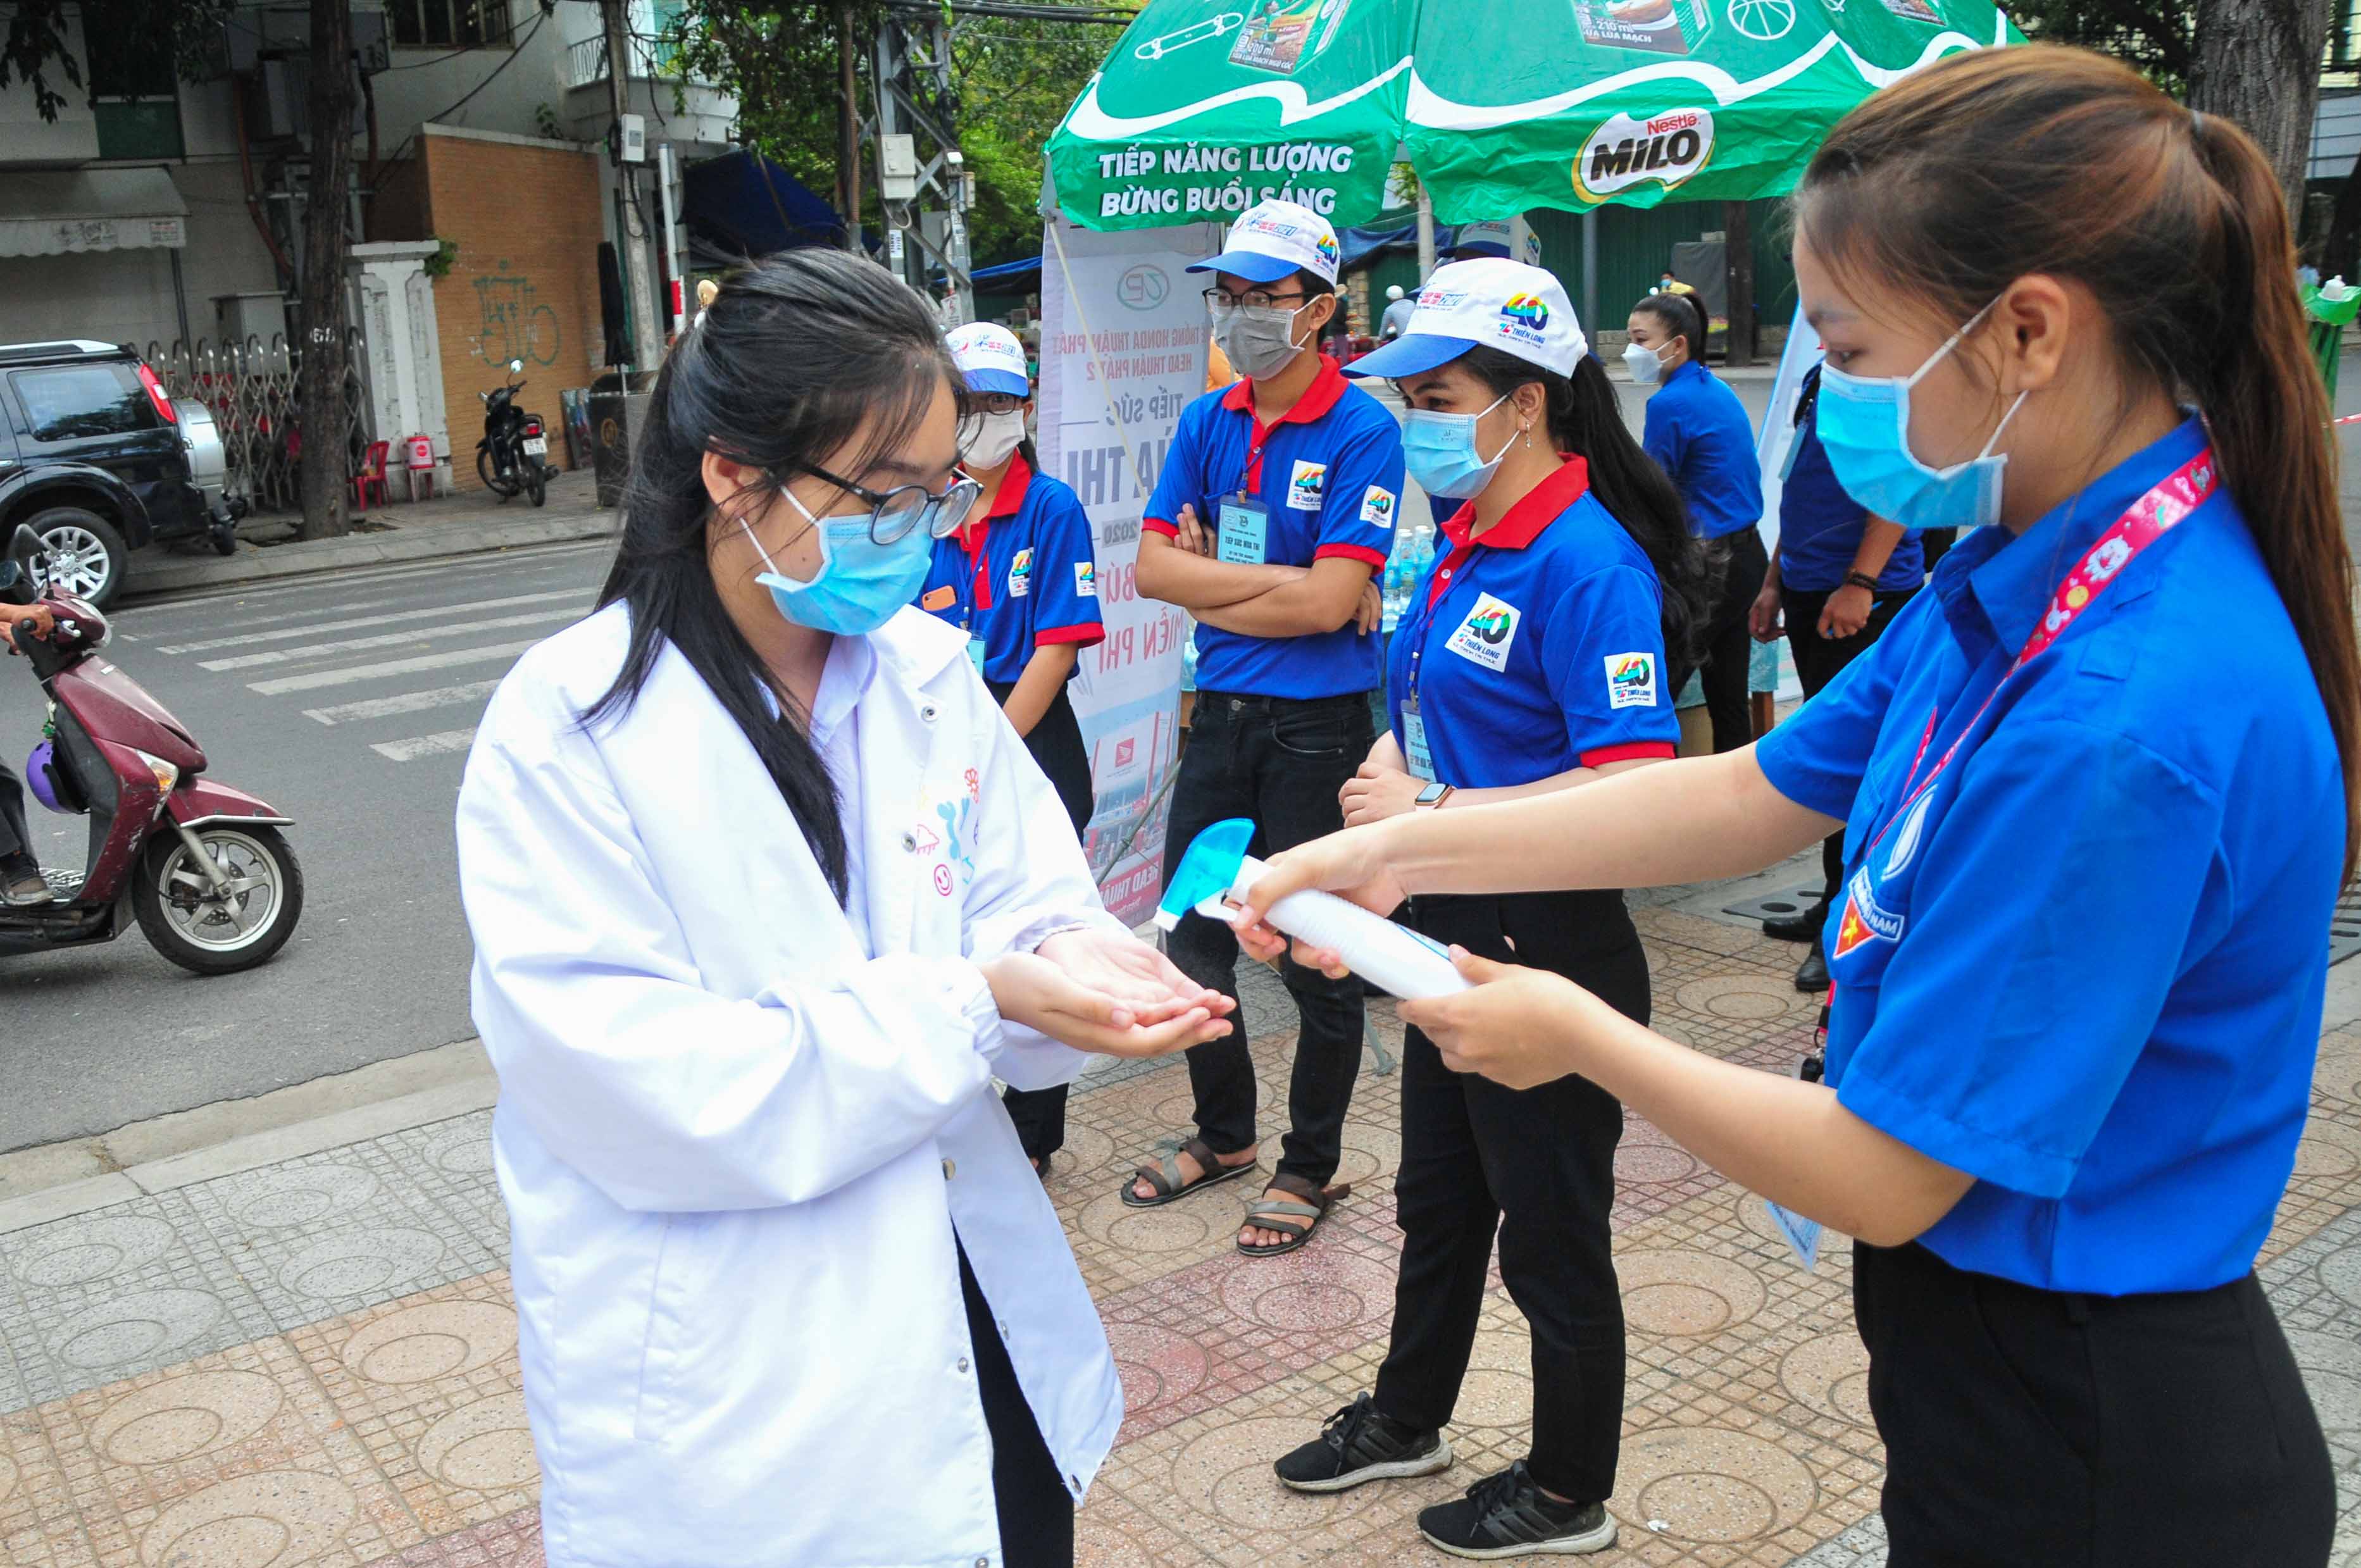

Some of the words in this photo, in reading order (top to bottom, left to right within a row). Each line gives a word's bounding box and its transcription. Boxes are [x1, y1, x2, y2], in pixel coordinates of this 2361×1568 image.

[1596, 20, 1617, 31] 210
[1248, 42, 1264, 54] 200
[1099, 142, 1157, 178] TIẾP
[1163, 140, 1241, 174] NĂNG
[1249, 141, 1355, 179] LƯỢNG
[1100, 184, 1180, 217] BỪNG
[1185, 176, 1252, 212] BUỔI
[1259, 180, 1337, 215] SÁNG
[1501, 292, 1549, 331] 40
[1295, 467, 1325, 494] 40
[1367, 490, 1391, 514] 40
[1467, 602, 1511, 645] 40
[1612, 657, 1650, 687] 40
